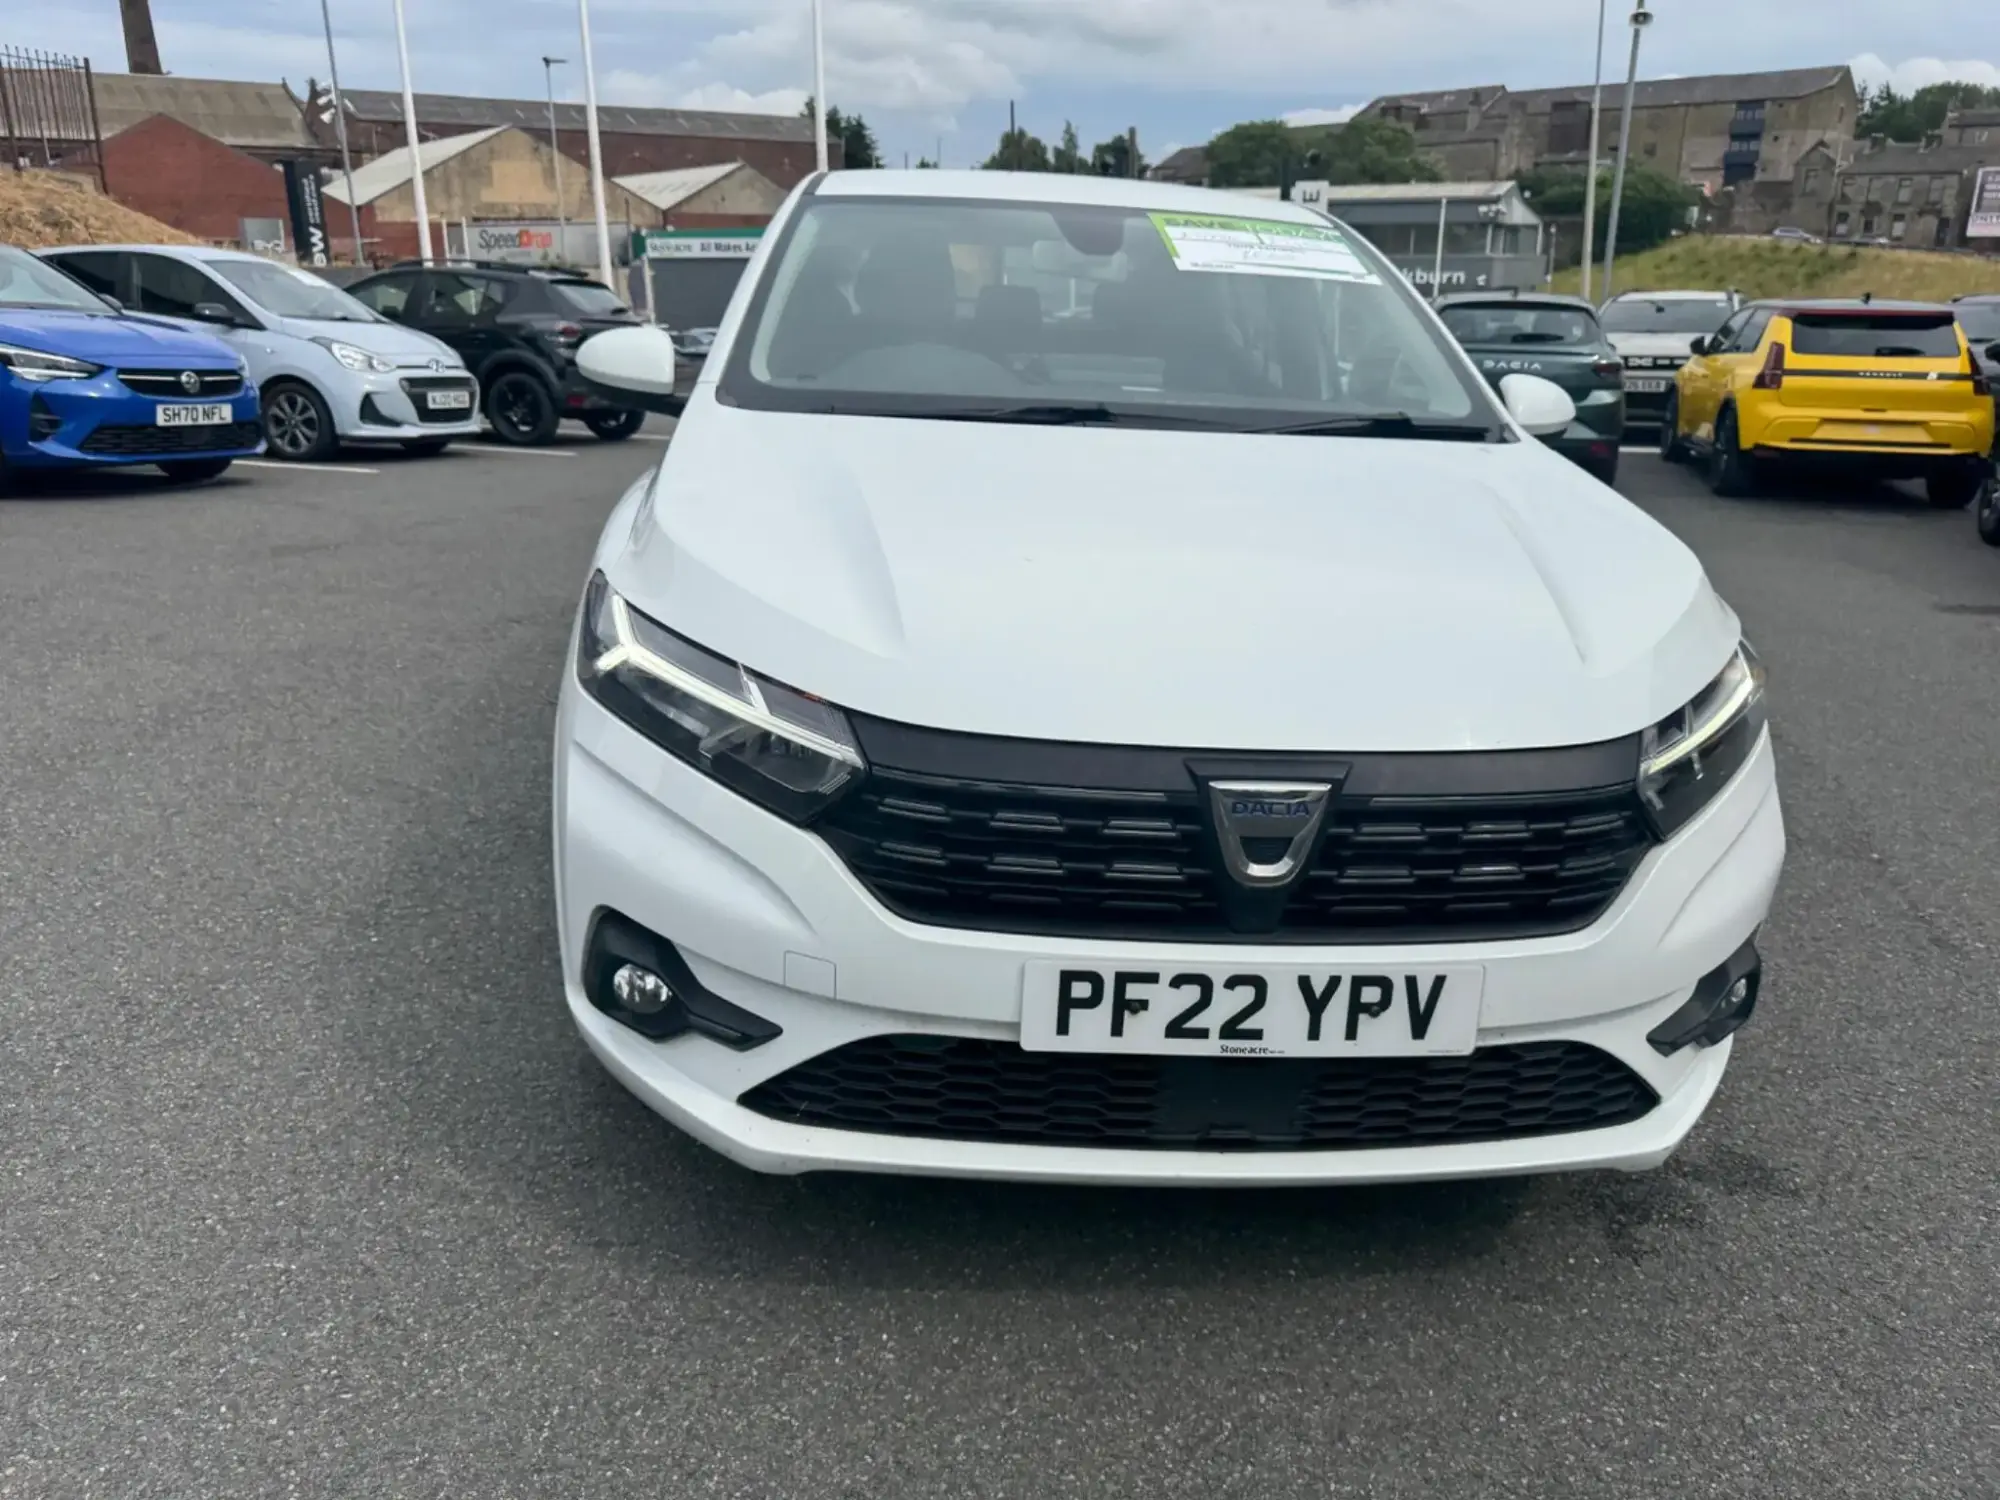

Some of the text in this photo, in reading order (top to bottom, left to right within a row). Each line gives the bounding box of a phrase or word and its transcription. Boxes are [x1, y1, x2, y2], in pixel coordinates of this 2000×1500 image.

[1401, 267, 1465, 284] kburn
[1483, 359, 1542, 370] DACIA
[163, 405, 227, 422] SH70 NFL
[1231, 801, 1309, 816] DACIA
[1056, 969, 1447, 1042] PF22 YPV
[1219, 1044, 1269, 1055] Stoneacre
